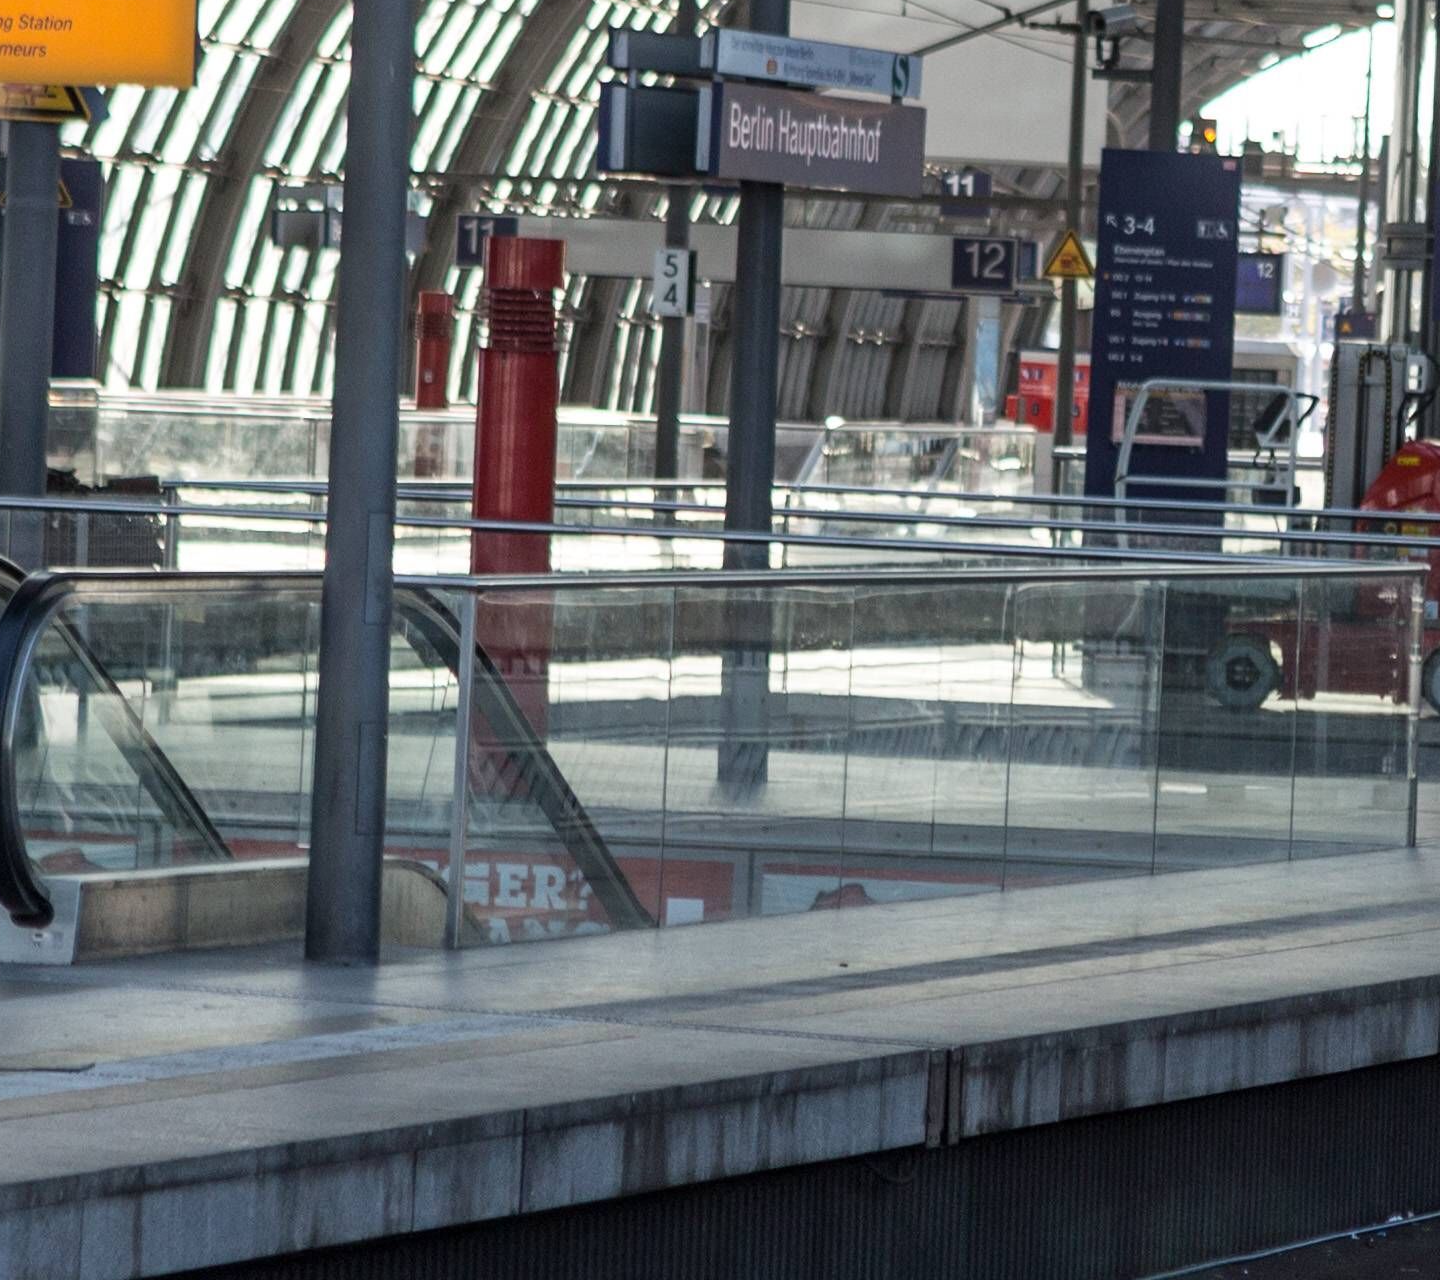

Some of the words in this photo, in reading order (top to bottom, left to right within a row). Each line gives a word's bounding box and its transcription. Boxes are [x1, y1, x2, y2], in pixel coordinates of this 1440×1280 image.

[17, 14, 73, 32] Station
[728, 101, 774, 154] Berlin
[777, 109, 883, 167] Hauptbahnhof
[945, 174, 974, 198] 11
[663, 253, 678, 278] 5
[965, 241, 1006, 280] 12
[663, 282, 678, 307] 4
